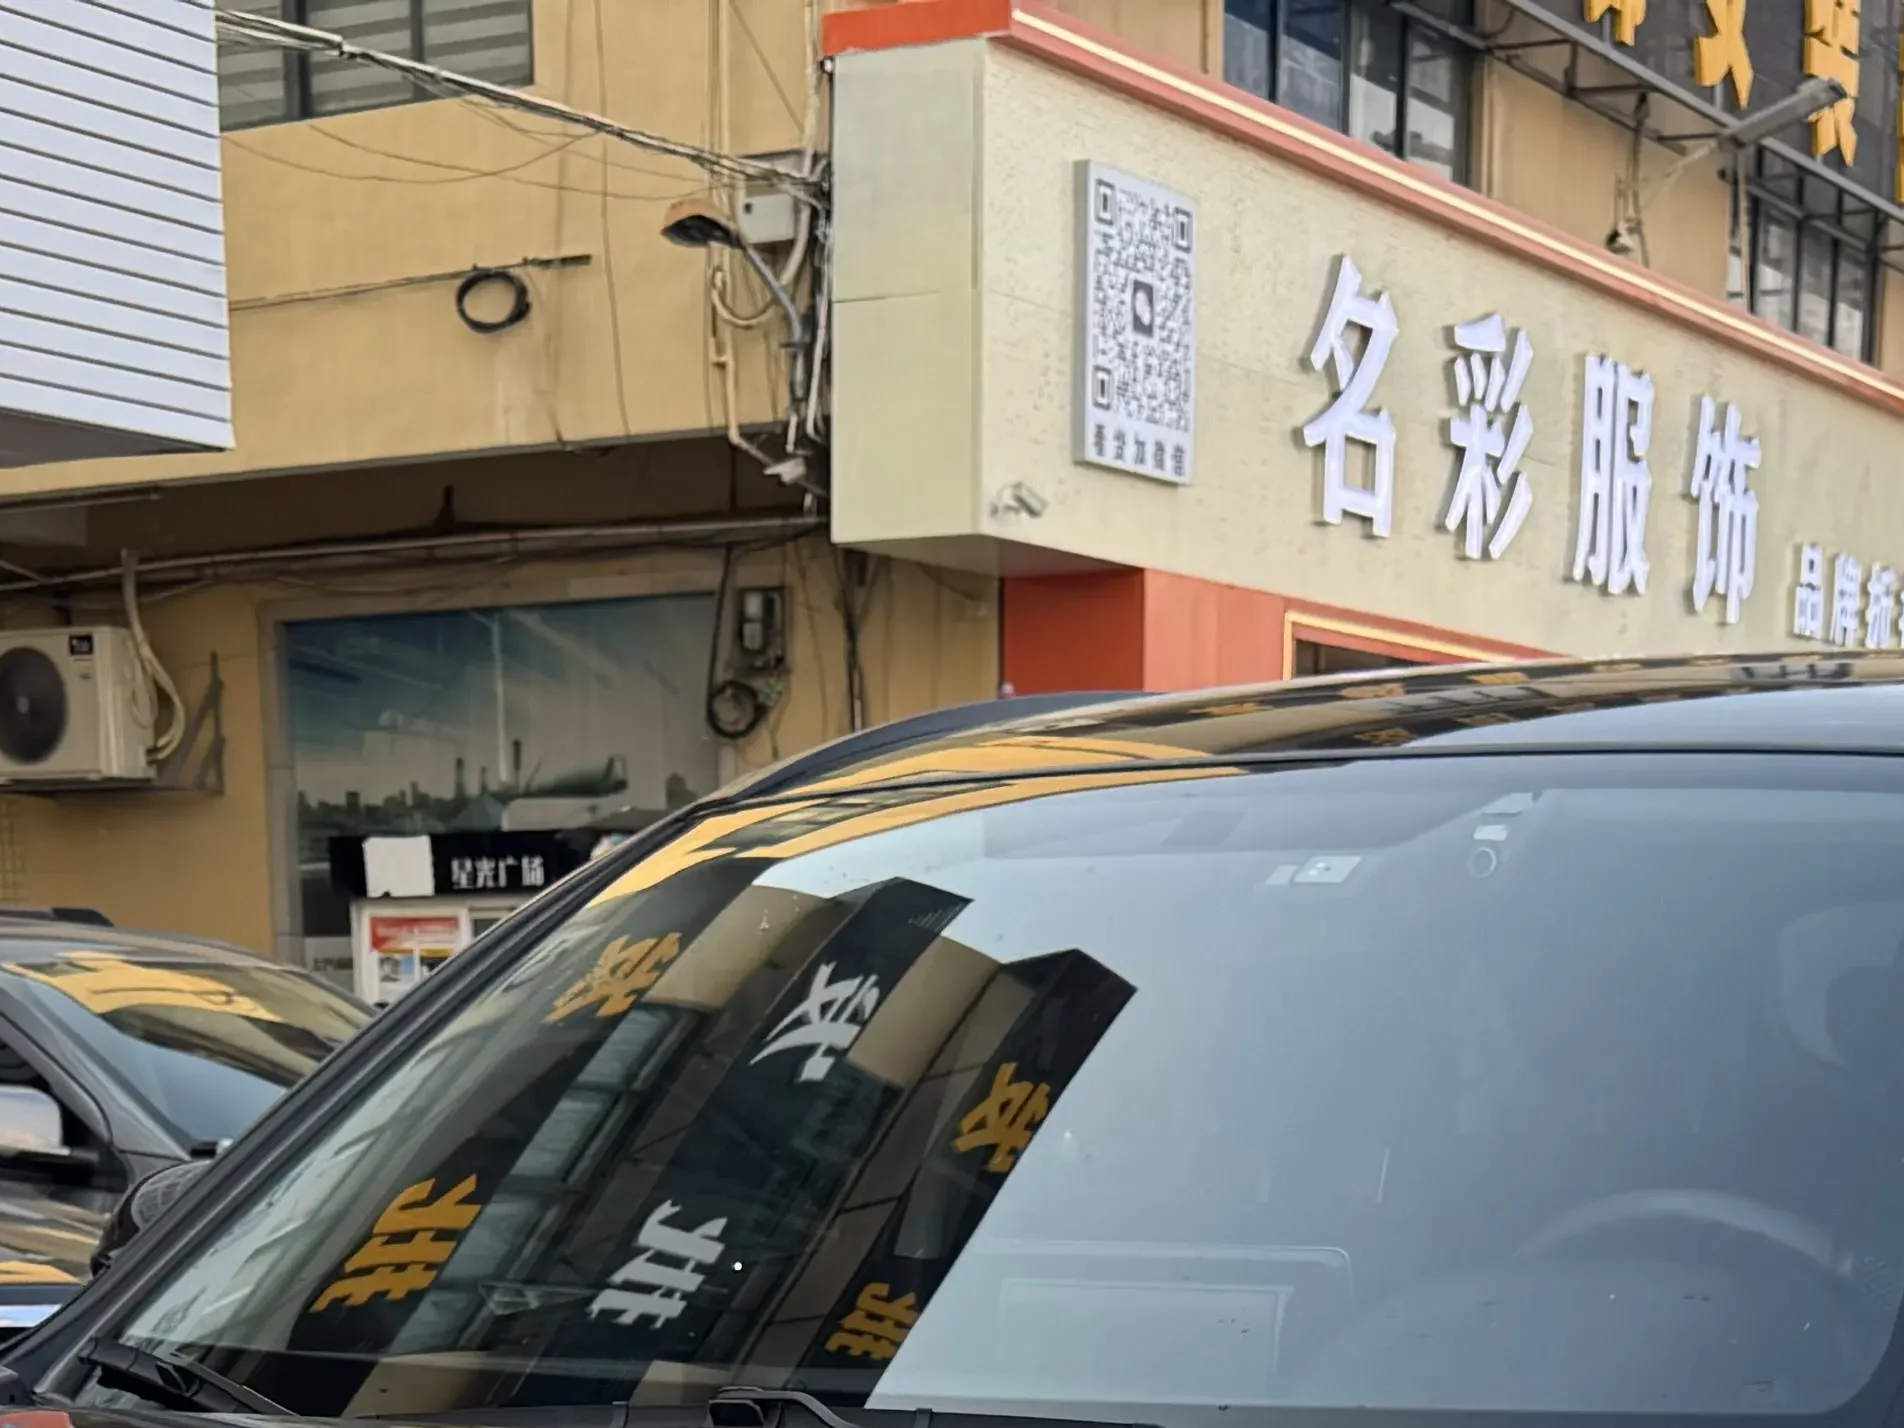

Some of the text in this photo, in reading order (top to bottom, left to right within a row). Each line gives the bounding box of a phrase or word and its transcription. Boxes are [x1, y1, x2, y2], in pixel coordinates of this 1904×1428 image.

[1303, 253, 1763, 625] 名彩服饰
[450, 855, 545, 889] 星光广场
